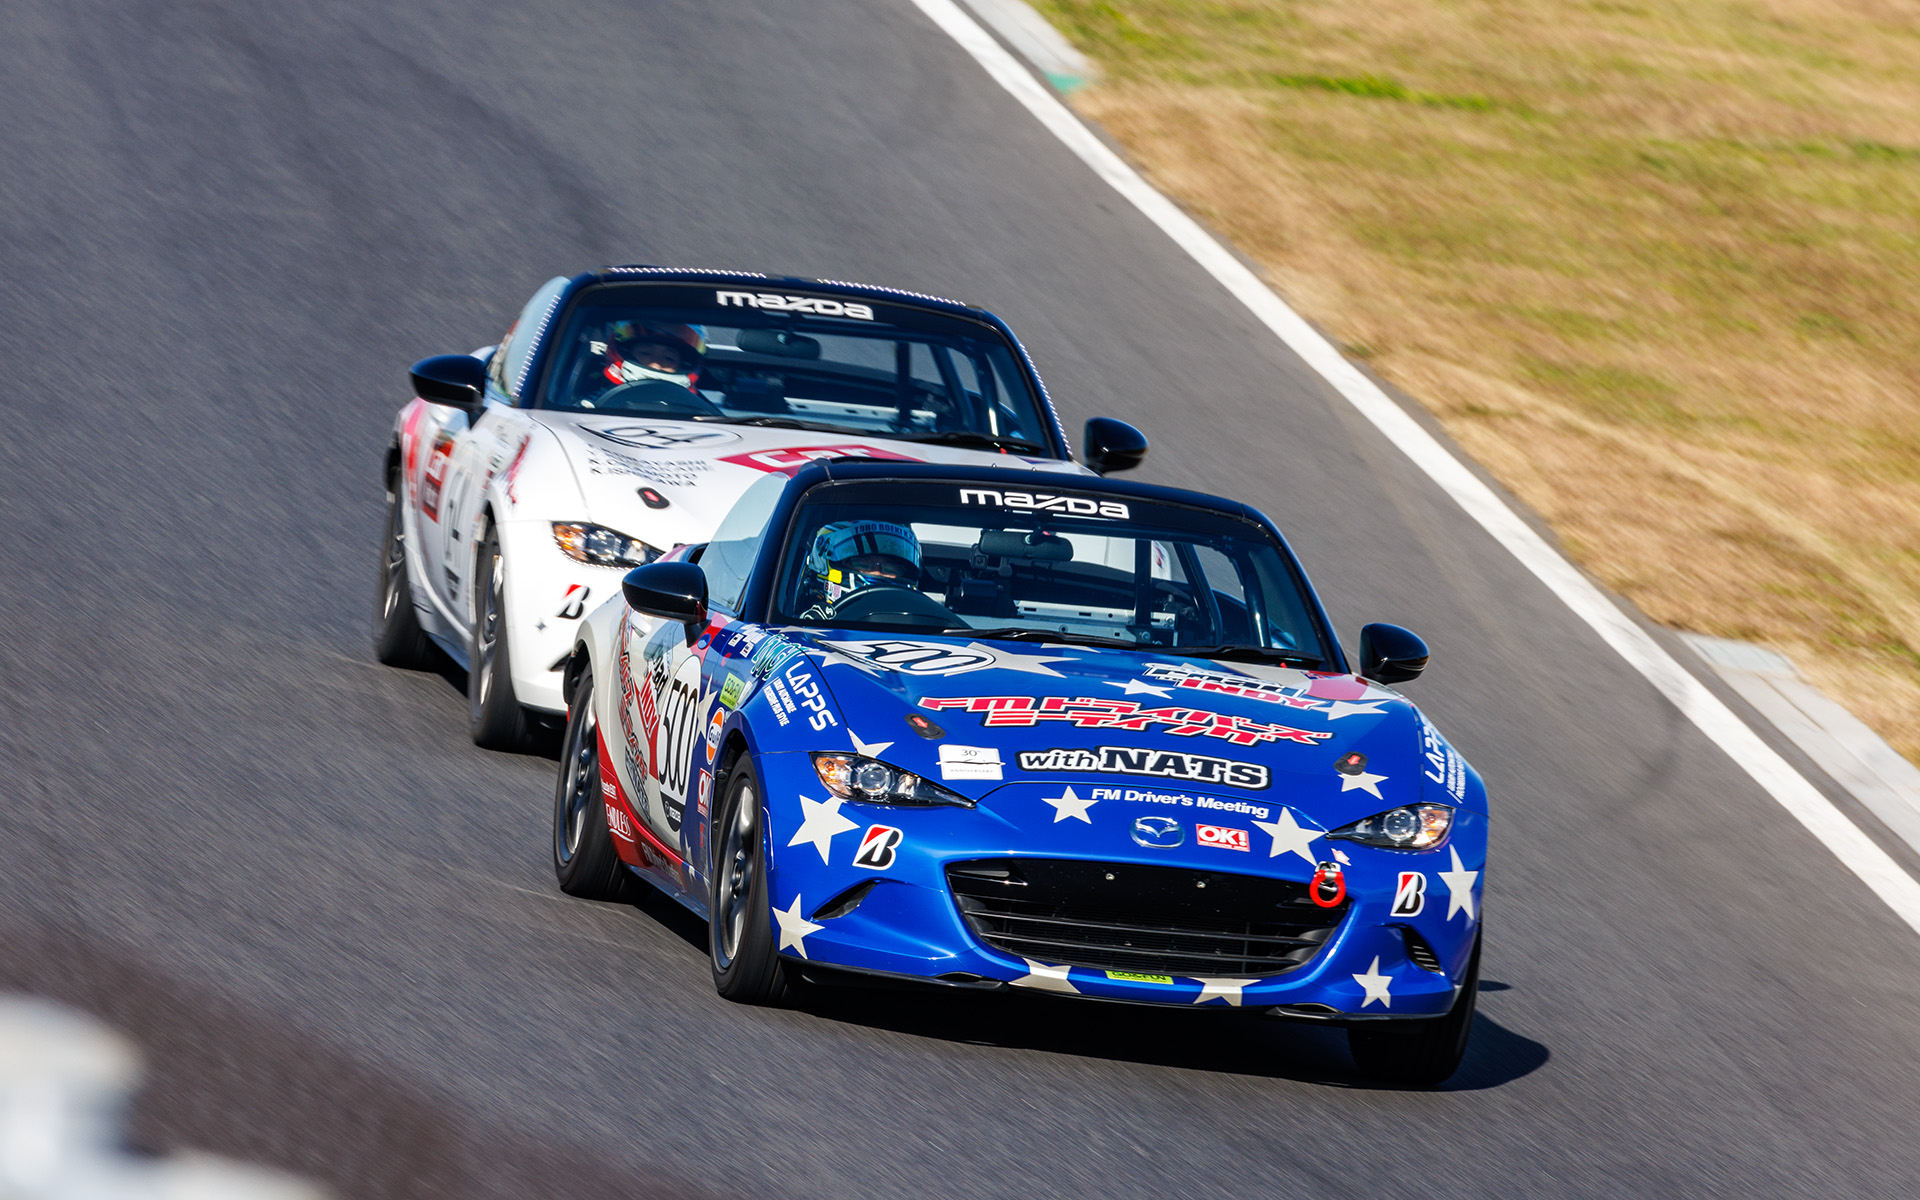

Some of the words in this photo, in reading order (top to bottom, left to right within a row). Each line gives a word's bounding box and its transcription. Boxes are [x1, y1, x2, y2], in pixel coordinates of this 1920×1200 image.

[716, 290, 874, 321] mazda
[960, 488, 1129, 519] mazda
[862, 641, 988, 671] 500
[659, 678, 698, 796] 500
[1021, 749, 1100, 772] with
[1100, 746, 1271, 790] NATS
[1091, 788, 1121, 800] FM
[1124, 790, 1194, 807] Driver's
[1196, 797, 1269, 819] Meeting
[1198, 826, 1247, 846] OK!
